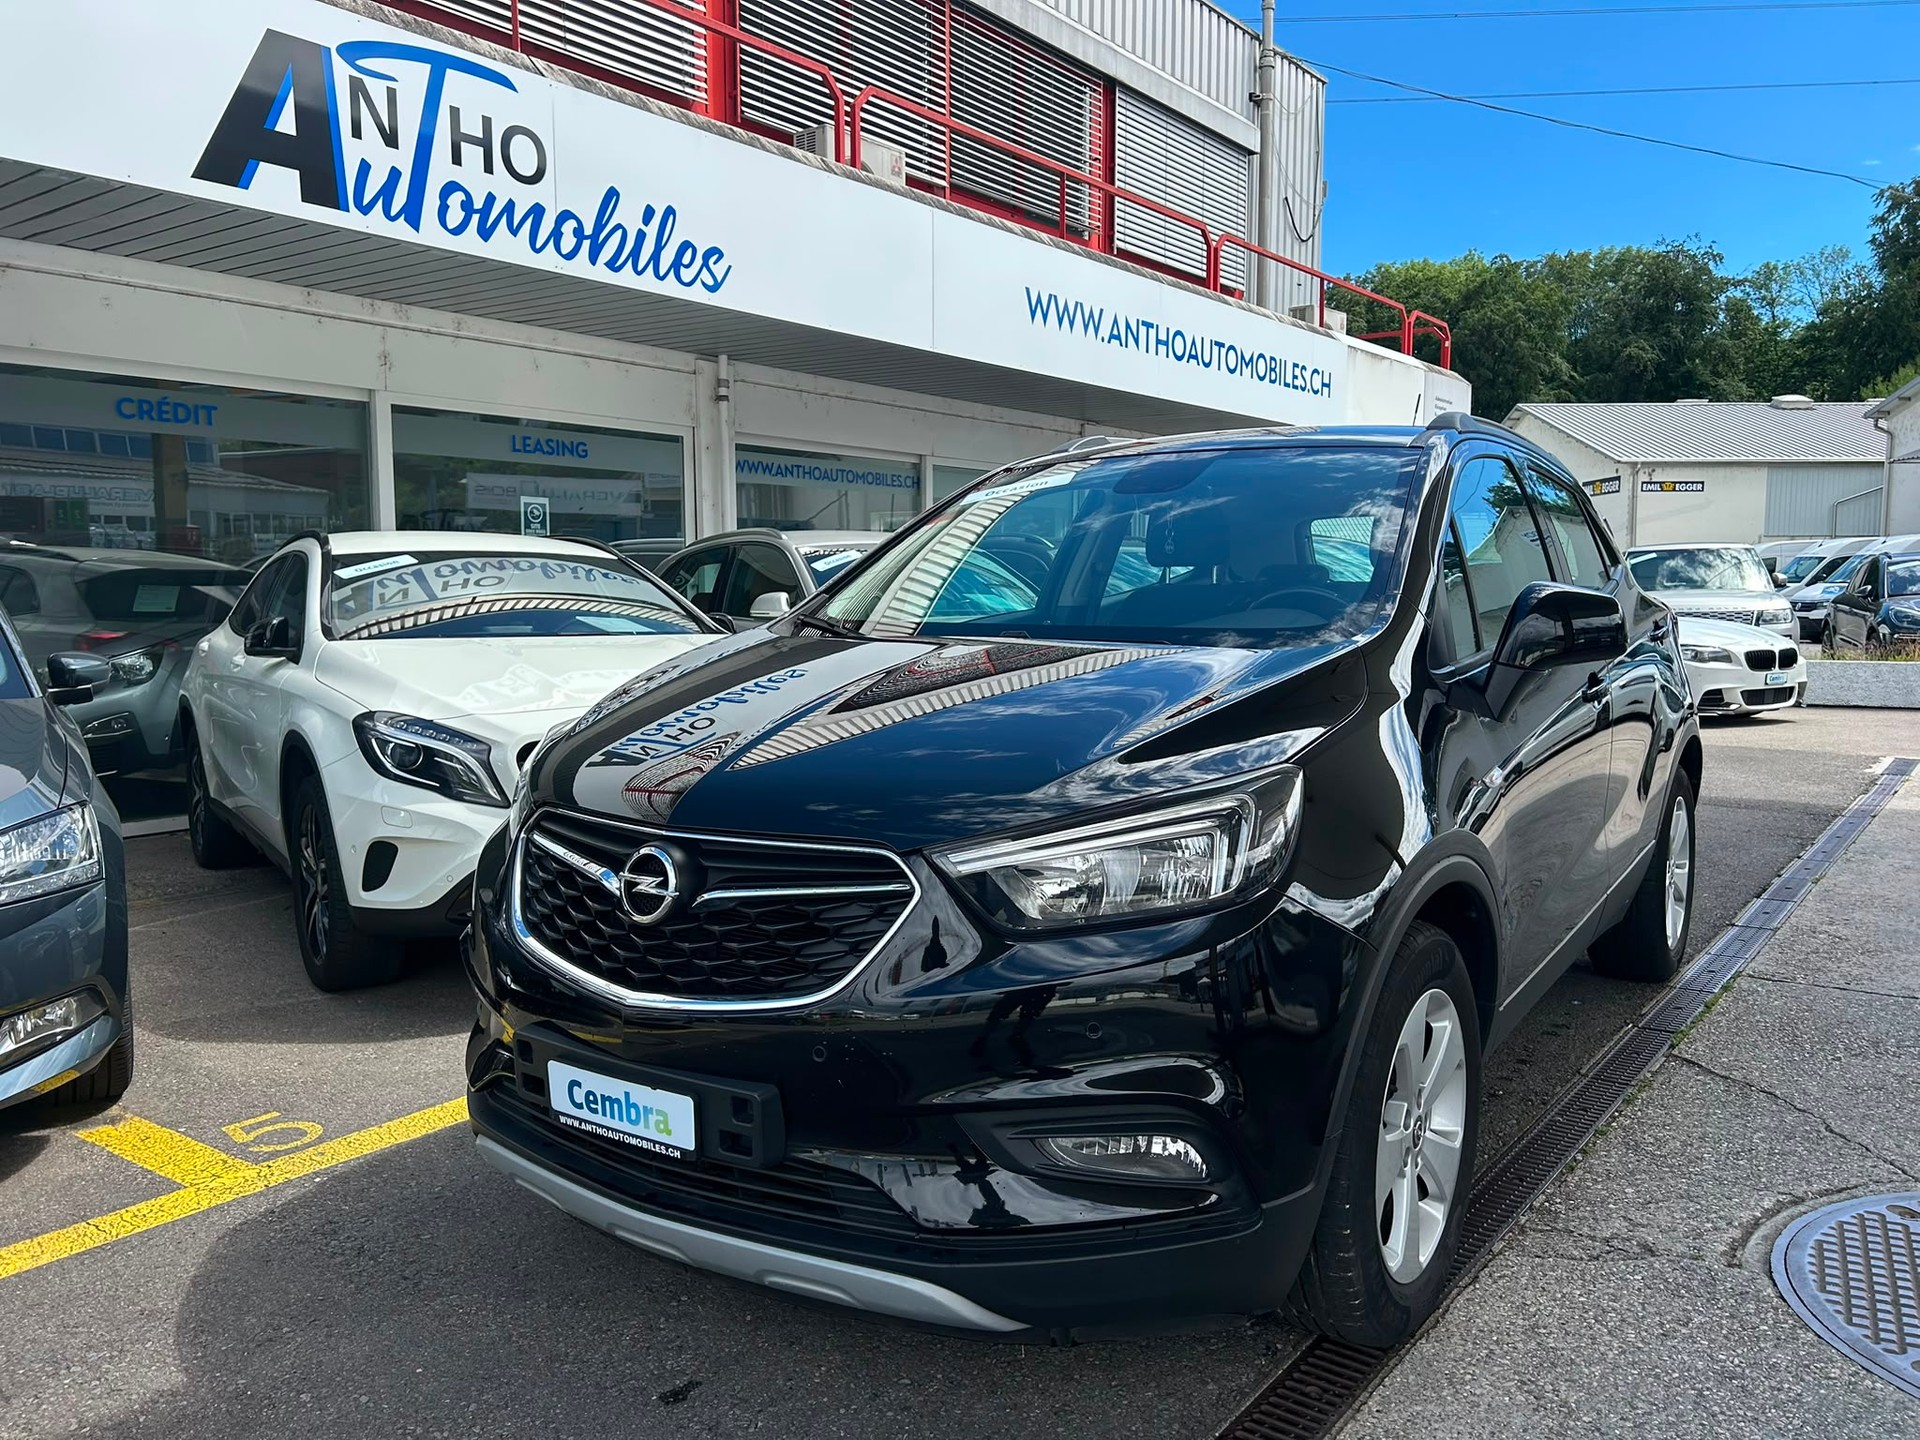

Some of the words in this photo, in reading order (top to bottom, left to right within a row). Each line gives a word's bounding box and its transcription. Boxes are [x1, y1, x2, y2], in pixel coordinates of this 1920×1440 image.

[192, 28, 548, 232] ANTHO
[1024, 286, 1332, 398] WWW.ANTHOAUTOMOBILES.CH
[116, 396, 218, 427] CRÉDIT
[512, 434, 588, 458] LEASING
[735, 457, 921, 489] WWW.ANTHOAUTOMOBILES.CH
[984, 480, 1048, 497] Occasion
[1642, 483, 1661, 491] EMIL
[1675, 483, 1703, 491] EGGER
[567, 1079, 672, 1136] Cembra
[221, 1110, 323, 1152] 5
[559, 1114, 681, 1159] WWW.ANTHOAUTOMOBILES.CH
